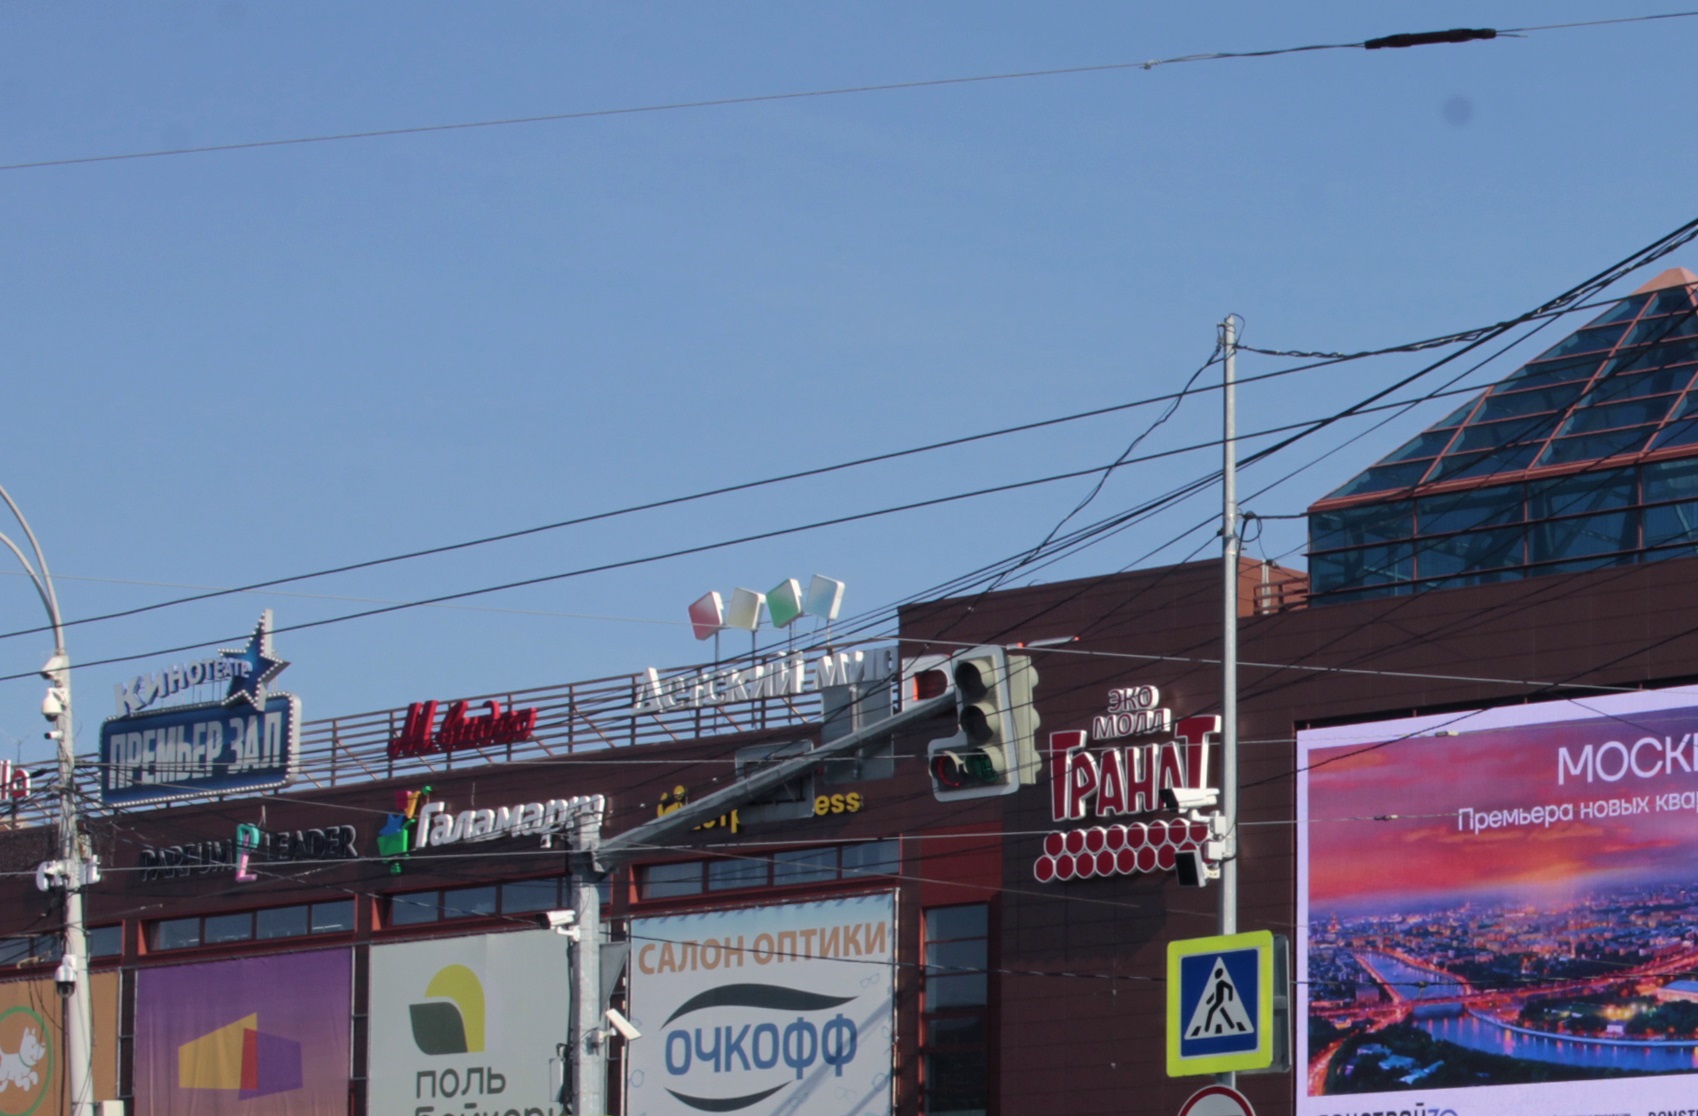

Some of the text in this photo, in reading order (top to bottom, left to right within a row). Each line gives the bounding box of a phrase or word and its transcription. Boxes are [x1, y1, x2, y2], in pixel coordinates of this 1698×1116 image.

[631, 651, 806, 716] Детский
[1108, 685, 1159, 713] ЭКО
[109, 720, 223, 790] ПРЕМЬЕР
[227, 711, 282, 774] ЗАЛ
[1093, 708, 1171, 740] МОЛЛ
[1050, 714, 1221, 821] ГРАНАТ
[416, 794, 605, 849] Галамарт
[1458, 803, 1573, 834] Премьера
[1580, 795, 1649, 819] новых
[264, 824, 358, 862] LEADER
[638, 921, 887, 974] САЛОН ОПТИКИ
[665, 1013, 858, 1080] ОЧКОФФ
[416, 1067, 506, 1099] поль
